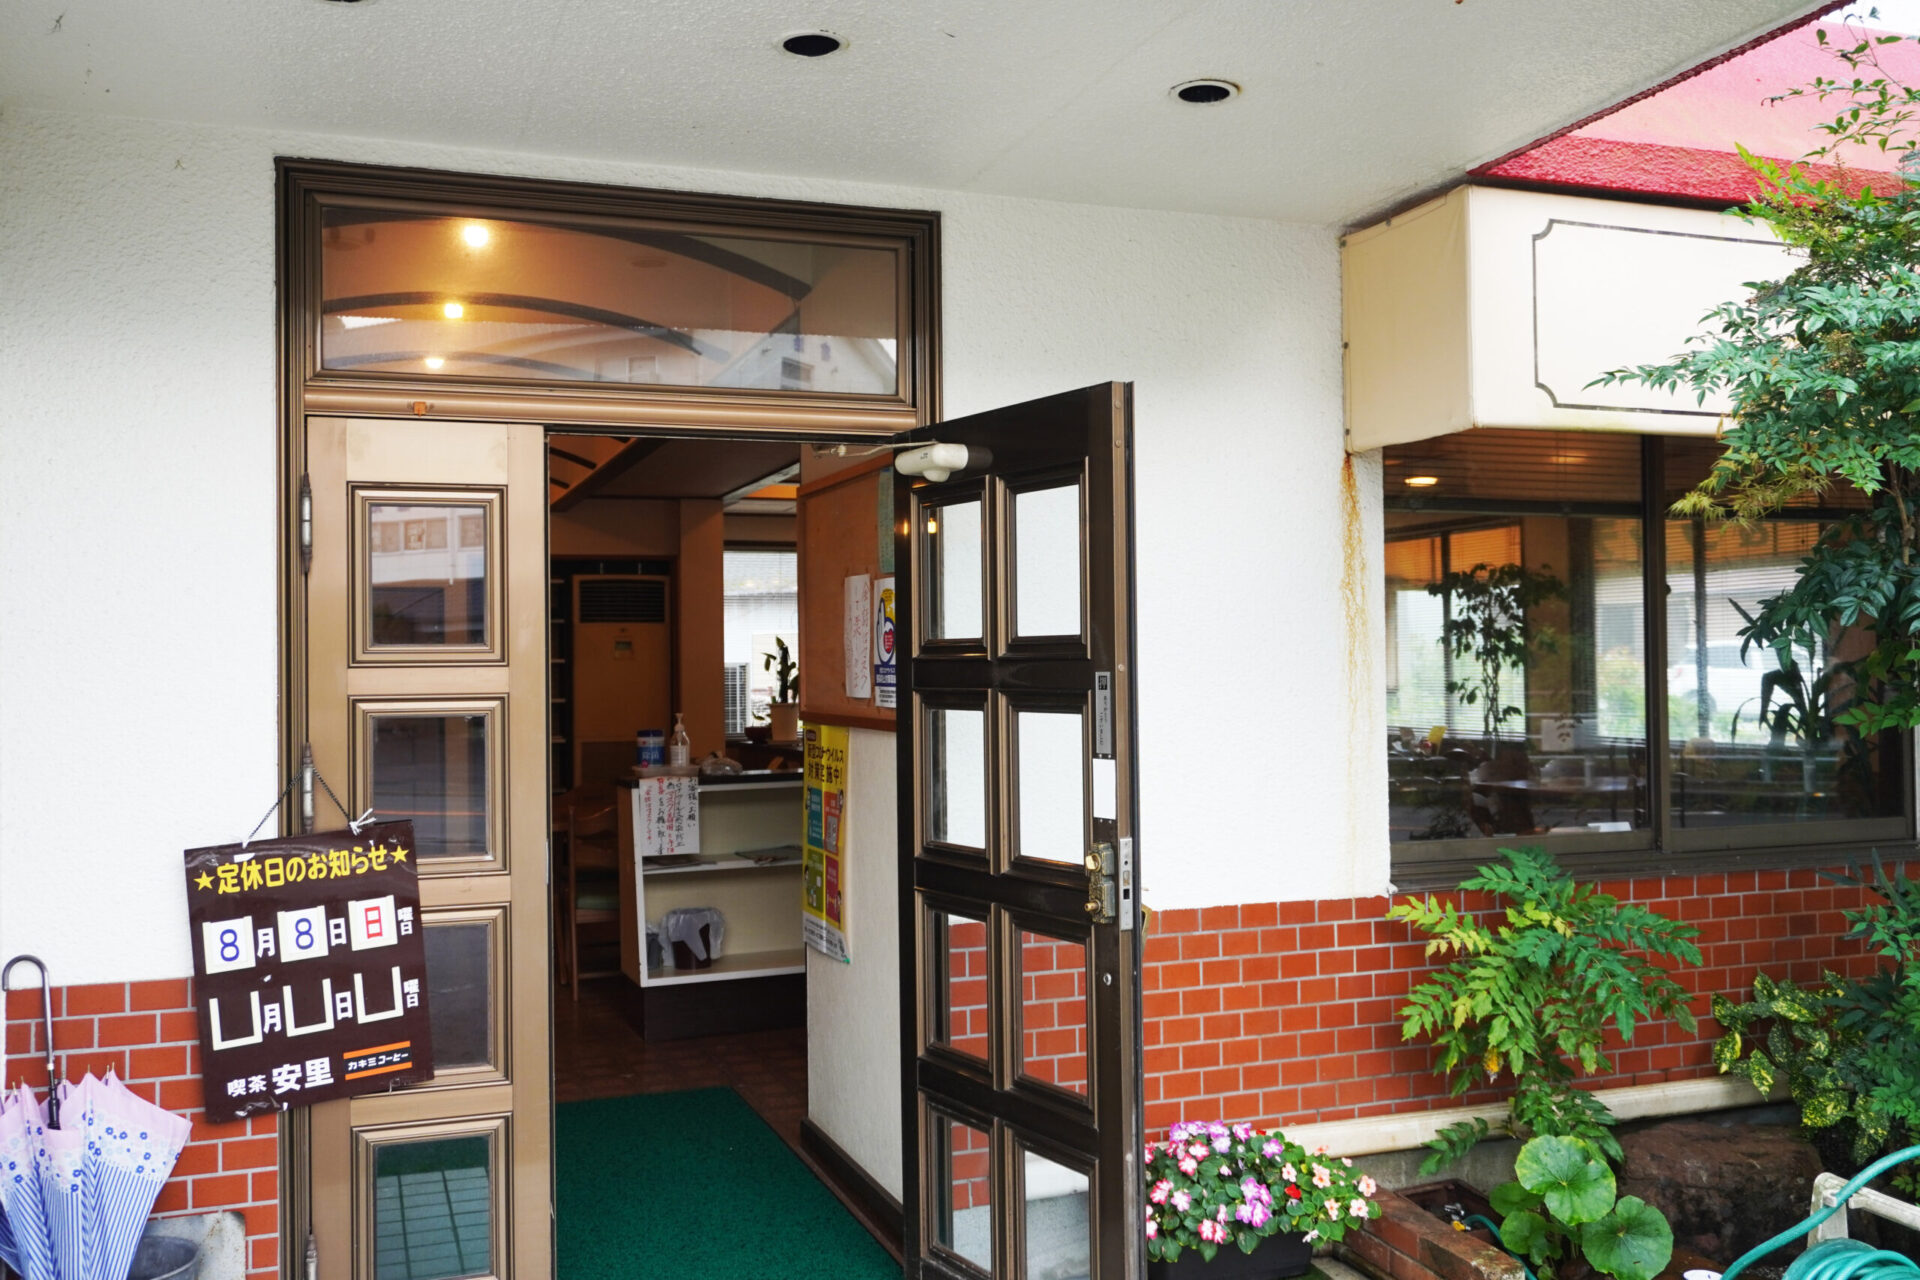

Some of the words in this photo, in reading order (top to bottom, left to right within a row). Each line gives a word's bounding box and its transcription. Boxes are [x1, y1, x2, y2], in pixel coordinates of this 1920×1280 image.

[217, 843, 388, 894] 定休日のお知らせ
[227, 1074, 267, 1097] 喫茶
[272, 1057, 334, 1095] 安里
